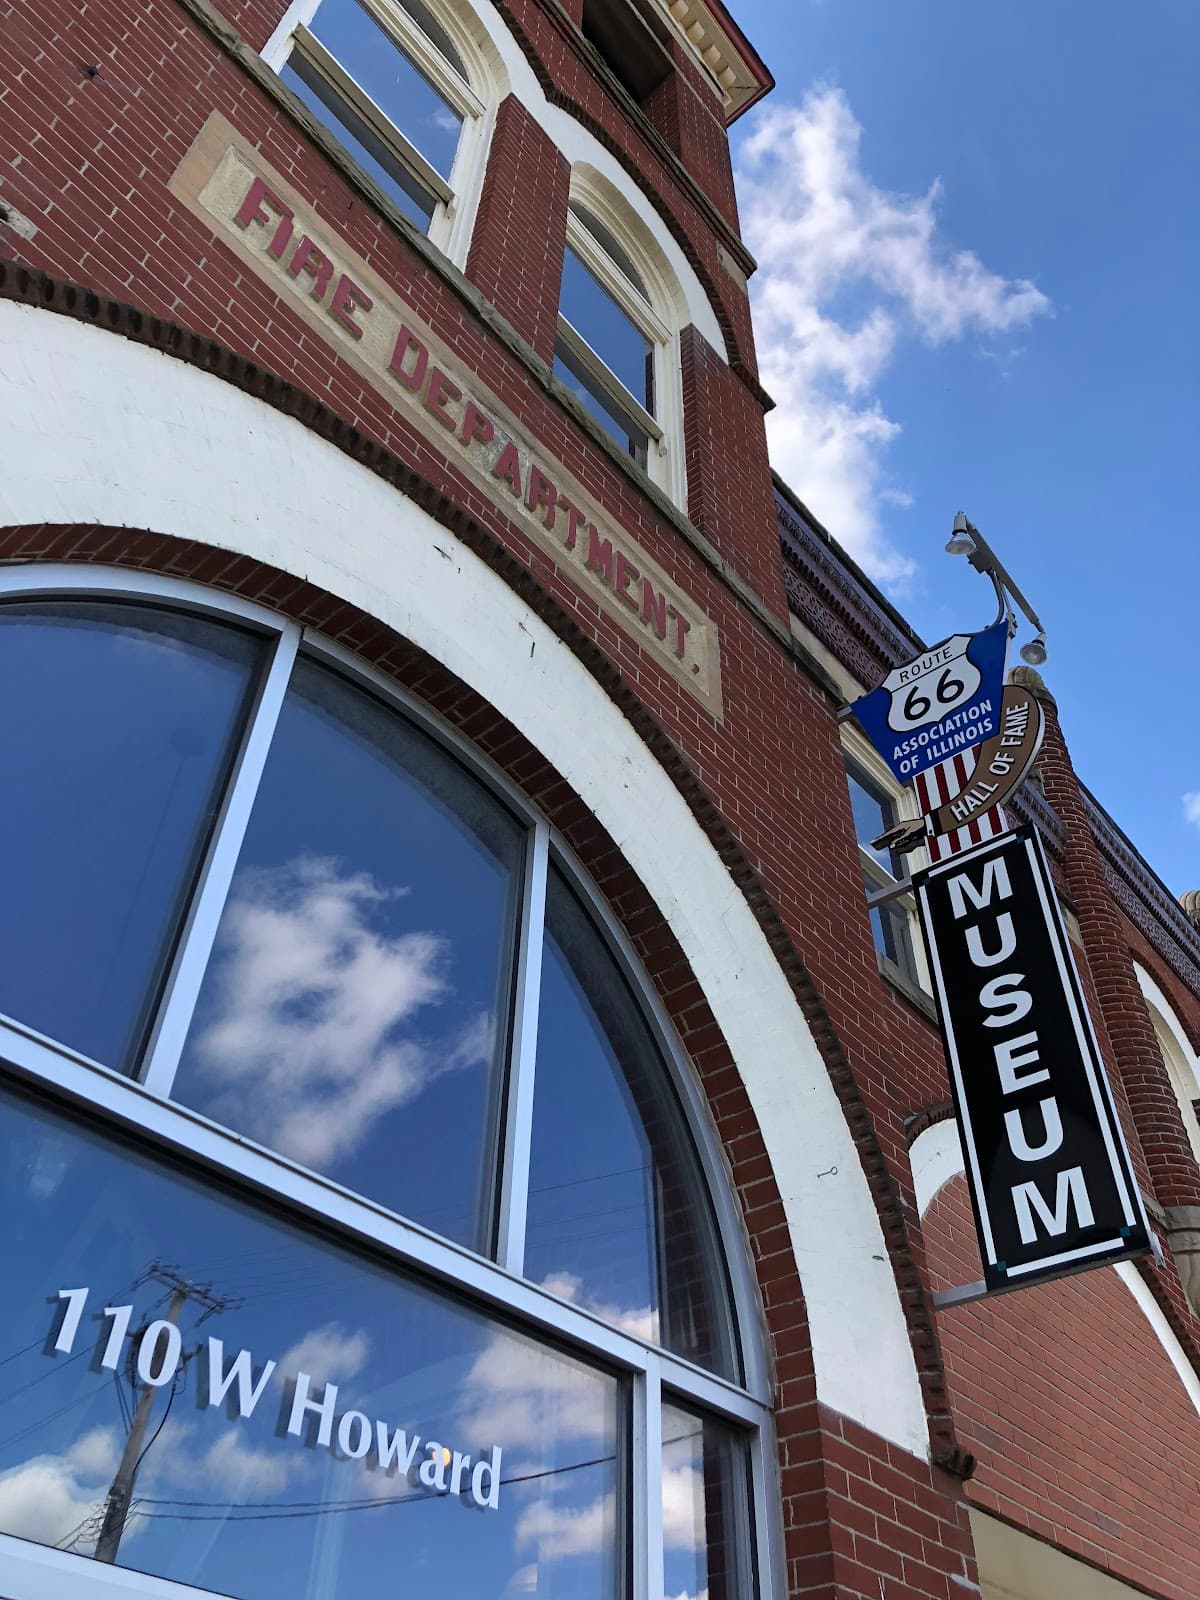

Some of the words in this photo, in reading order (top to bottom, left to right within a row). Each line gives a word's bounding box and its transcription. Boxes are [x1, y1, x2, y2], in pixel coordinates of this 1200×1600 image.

[234, 176, 374, 342] FIRE
[899, 648, 953, 682] ROUTE
[903, 669, 965, 721] 66
[893, 699, 993, 761] ASSOCIATION
[899, 757, 919, 775] OF
[927, 717, 993, 763] ILLINOIS
[1000, 700, 1029, 746] FAME
[989, 751, 1013, 775] OF
[952, 780, 999, 822] HALL
[946, 855, 1096, 1246] MUSEUM
[54, 1287, 182, 1387] 110
[208, 1336, 277, 1419] W
[287, 1372, 503, 1510] Howard
